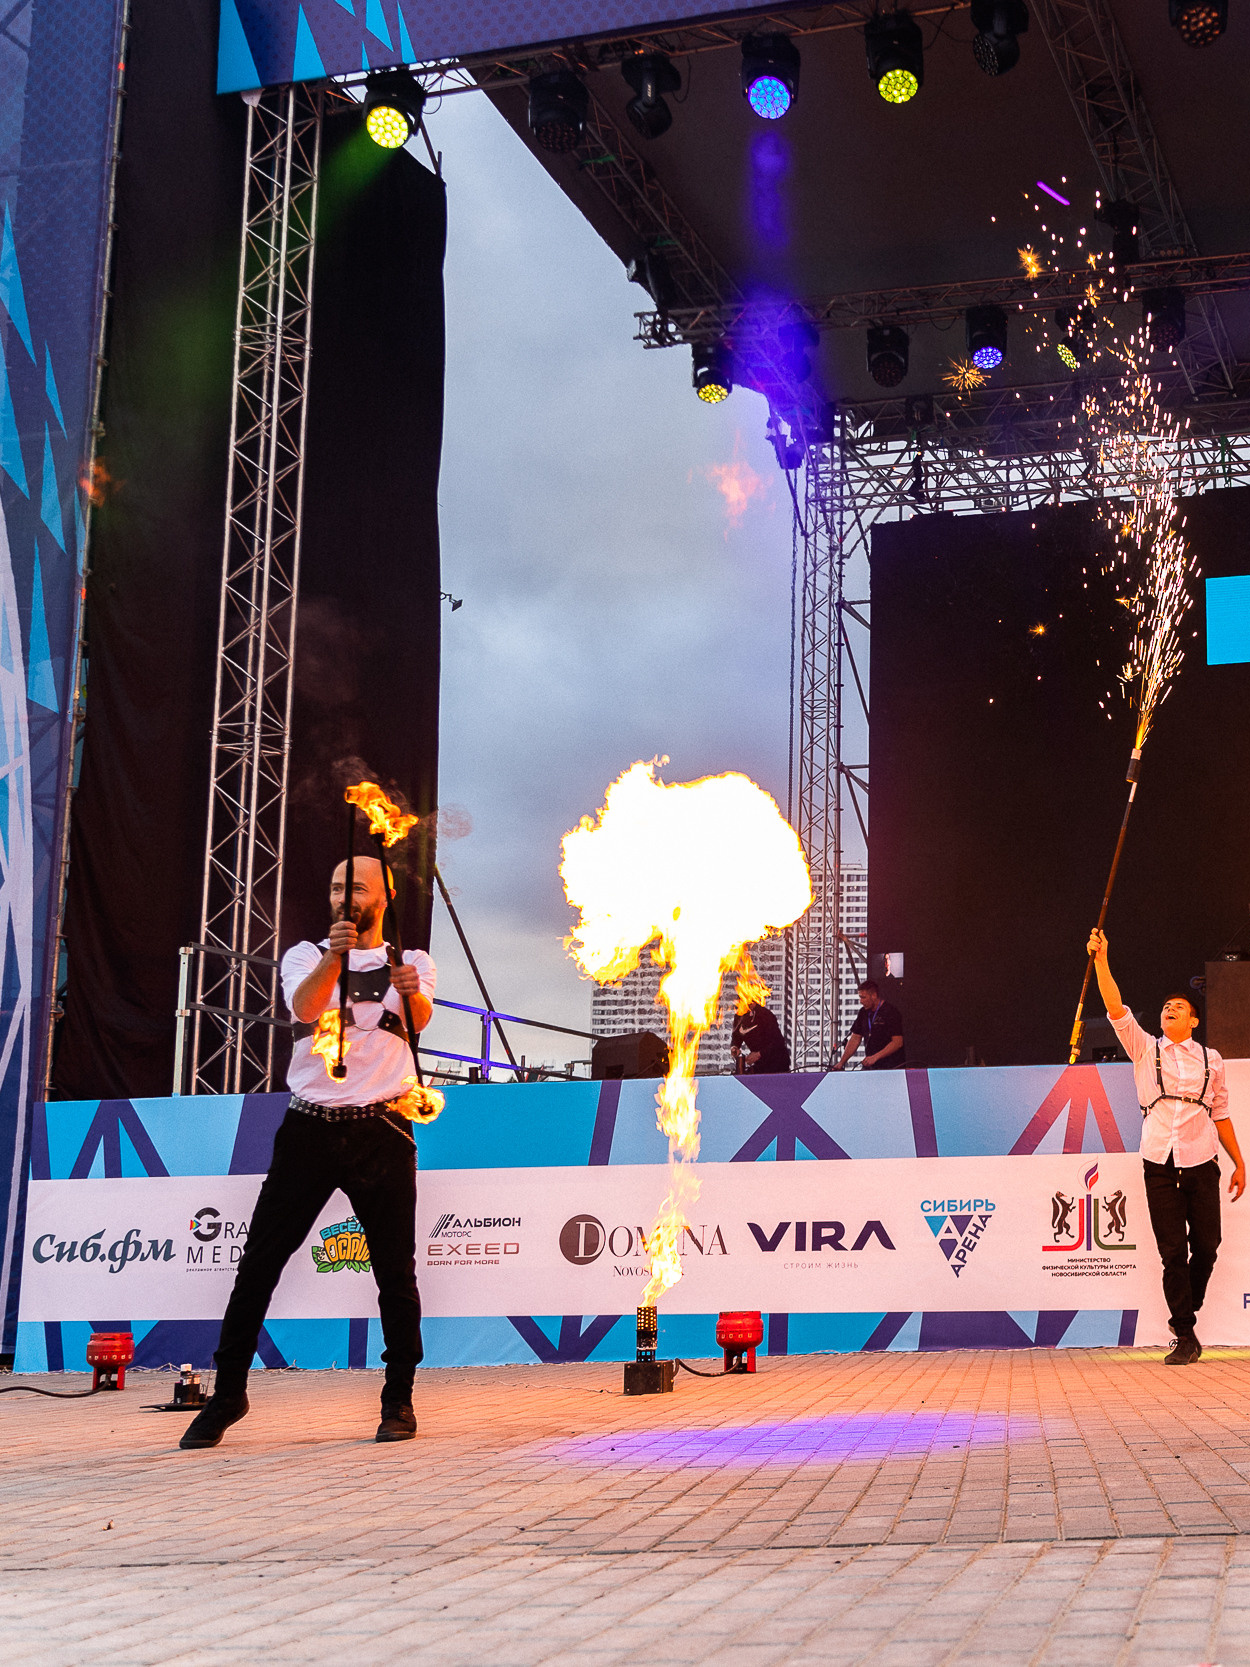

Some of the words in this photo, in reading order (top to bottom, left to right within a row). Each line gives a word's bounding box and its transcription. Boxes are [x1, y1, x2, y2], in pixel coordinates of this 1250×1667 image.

[920, 1199, 996, 1213] СИБИРЬ
[193, 1207, 249, 1242] GRA
[452, 1217, 521, 1228] АЛЬБИОН
[747, 1220, 896, 1252] VIRA
[32, 1228, 176, 1274] Сиб.фм
[186, 1246, 243, 1263] MED
[428, 1243, 519, 1256] EXEED
[574, 1221, 731, 1258] DOMNA
[951, 1214, 993, 1278] АРЕНА
